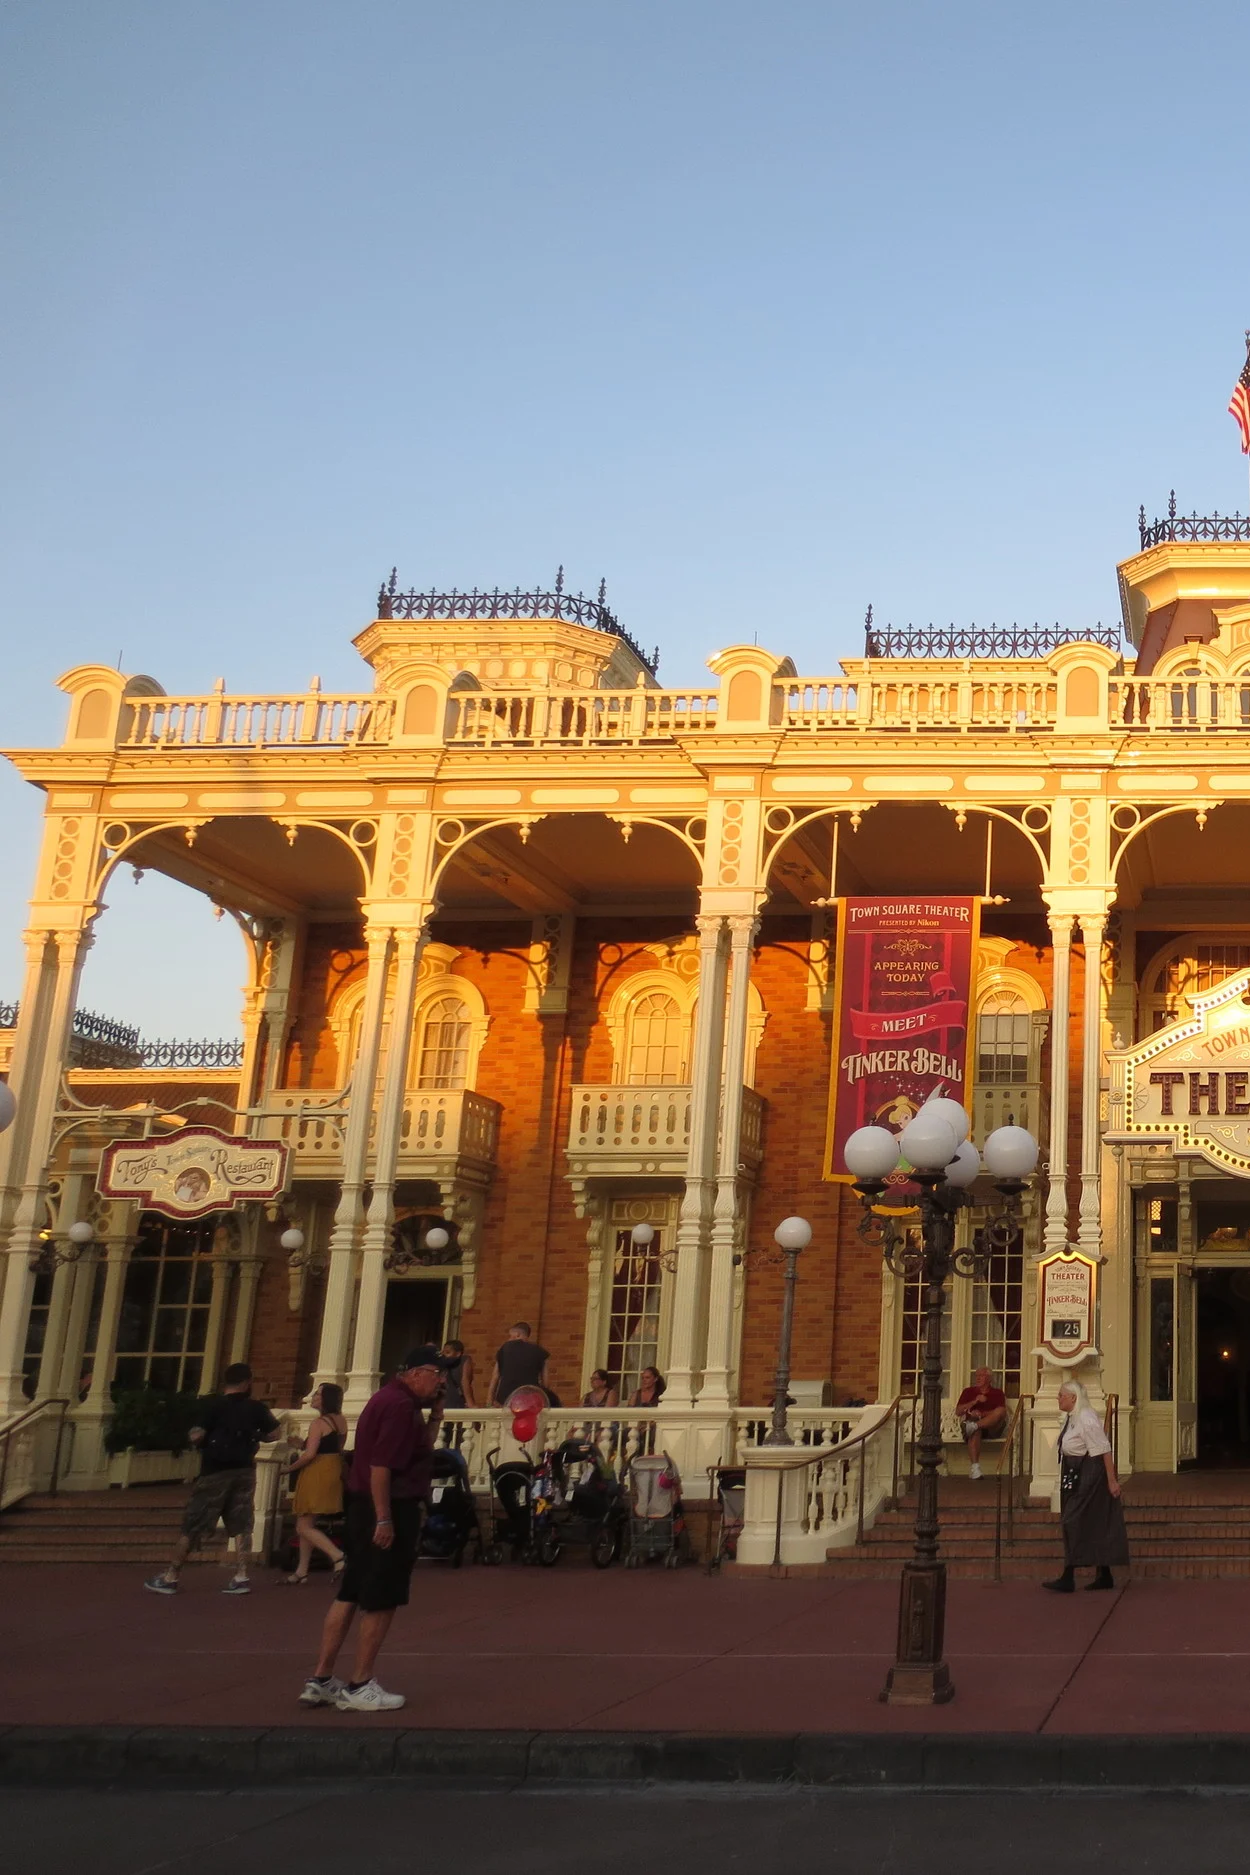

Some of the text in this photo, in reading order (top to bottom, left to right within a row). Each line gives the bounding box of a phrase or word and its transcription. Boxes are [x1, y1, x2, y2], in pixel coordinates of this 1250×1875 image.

[850, 904, 970, 923] TOWN SQUARE THEATER
[917, 918, 940, 927] Nikon
[874, 961, 939, 972] APPEARING
[886, 973, 926, 983] TODAY
[881, 1012, 928, 1033] MEET
[1201, 1026, 1250, 1057] TOWN
[841, 1047, 963, 1085] TINKER BELL
[117, 1154, 168, 1185] Tony's
[210, 1149, 275, 1186] Restaurant
[1051, 1272, 1085, 1280] THEATER
[1047, 1294, 1087, 1306] TINKER BELL
[1064, 1322, 1080, 1335] 25
